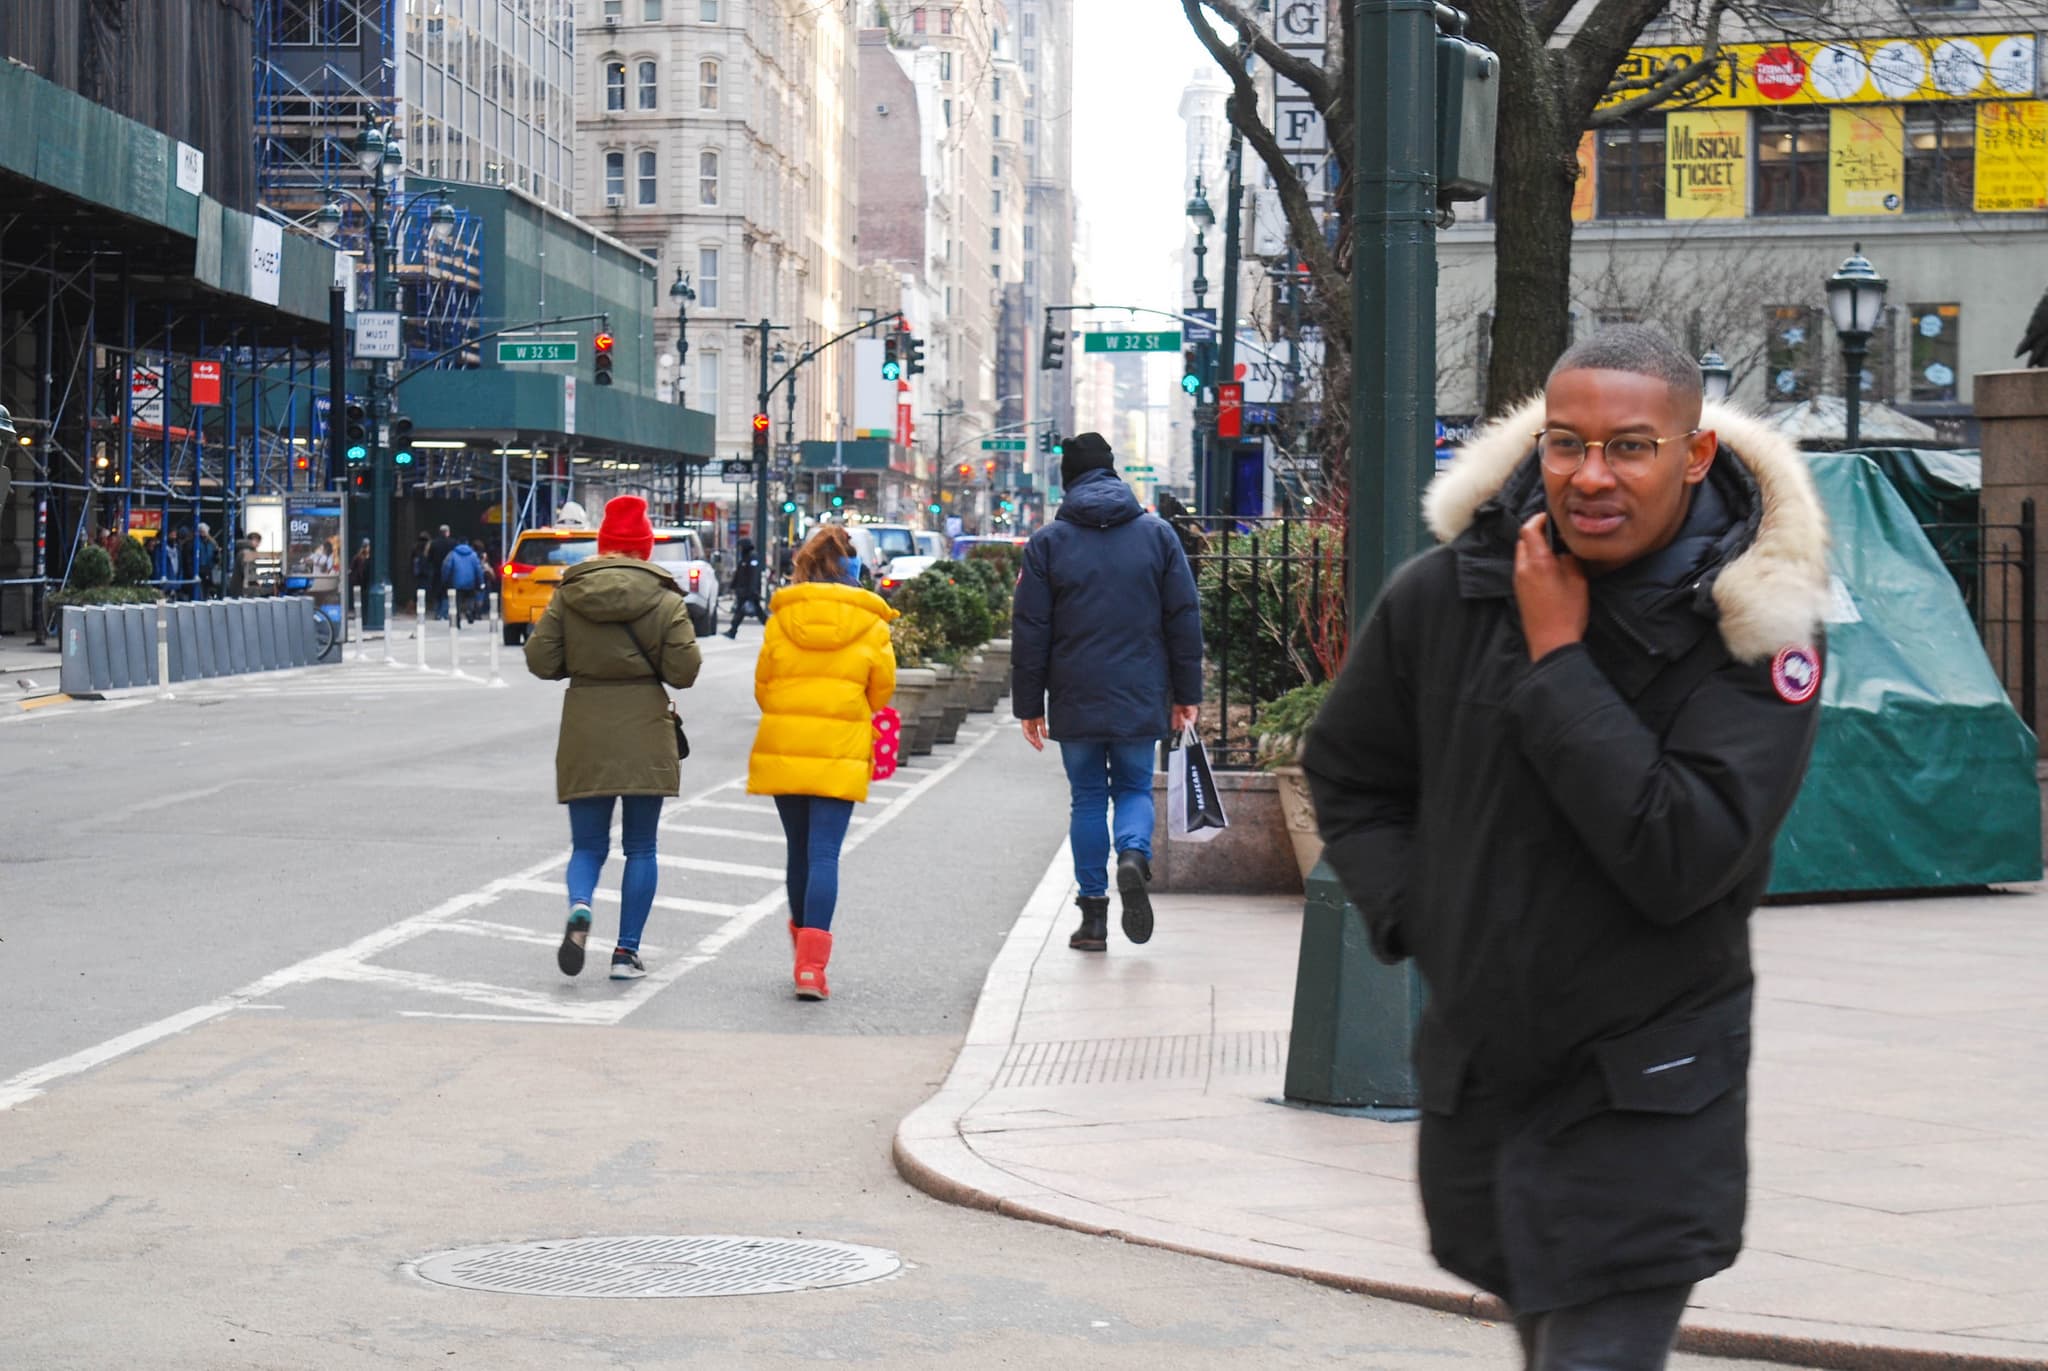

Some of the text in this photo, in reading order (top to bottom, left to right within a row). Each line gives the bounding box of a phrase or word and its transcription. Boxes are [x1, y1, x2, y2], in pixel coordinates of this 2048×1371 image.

[366, 330, 388, 339] MUST
[1105, 335, 1160, 349] W 32 St
[516, 346, 559, 359] W 32 St
[289, 519, 309, 534] Big
